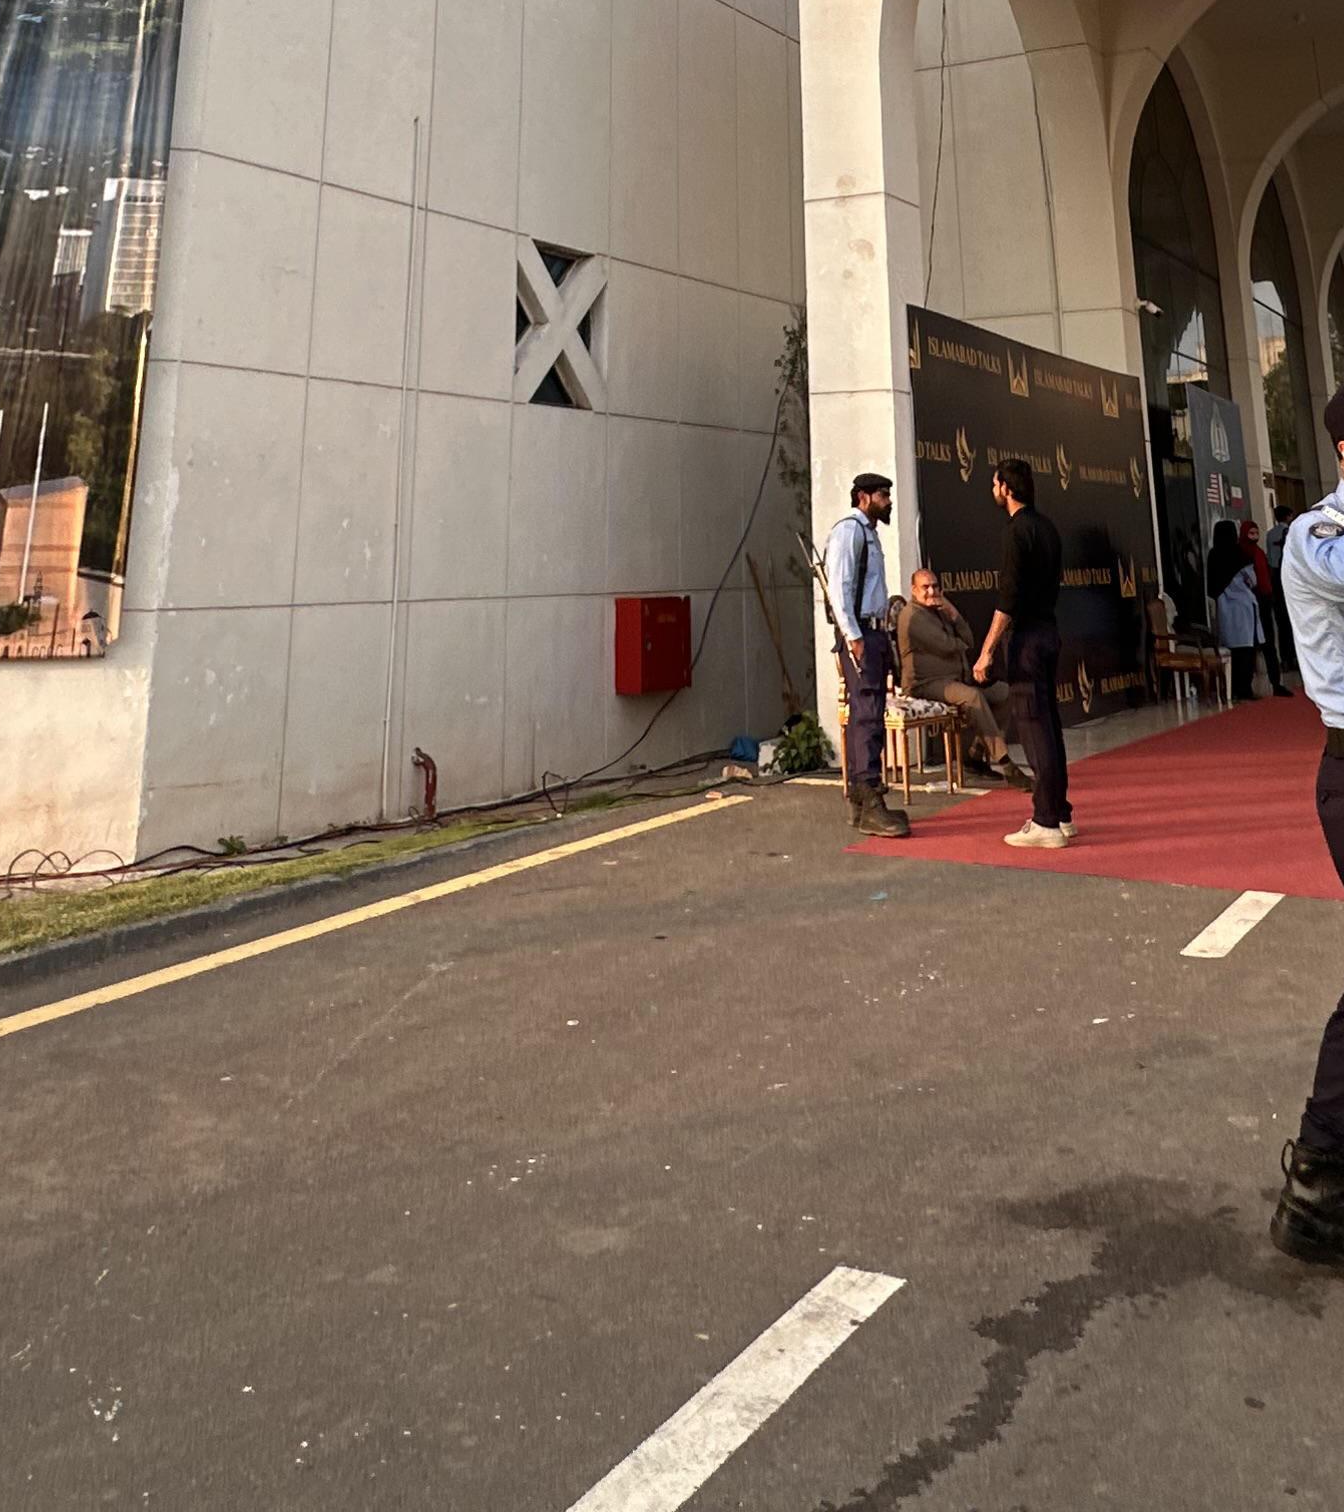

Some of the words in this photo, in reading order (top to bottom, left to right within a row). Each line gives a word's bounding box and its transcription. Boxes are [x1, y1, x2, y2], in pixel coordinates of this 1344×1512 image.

[928, 336, 977, 366] ISLAMABAD
[977, 350, 1002, 375] TALKS
[924, 440, 951, 462] TALKS
[940, 570, 993, 592] ISLAMABAD
